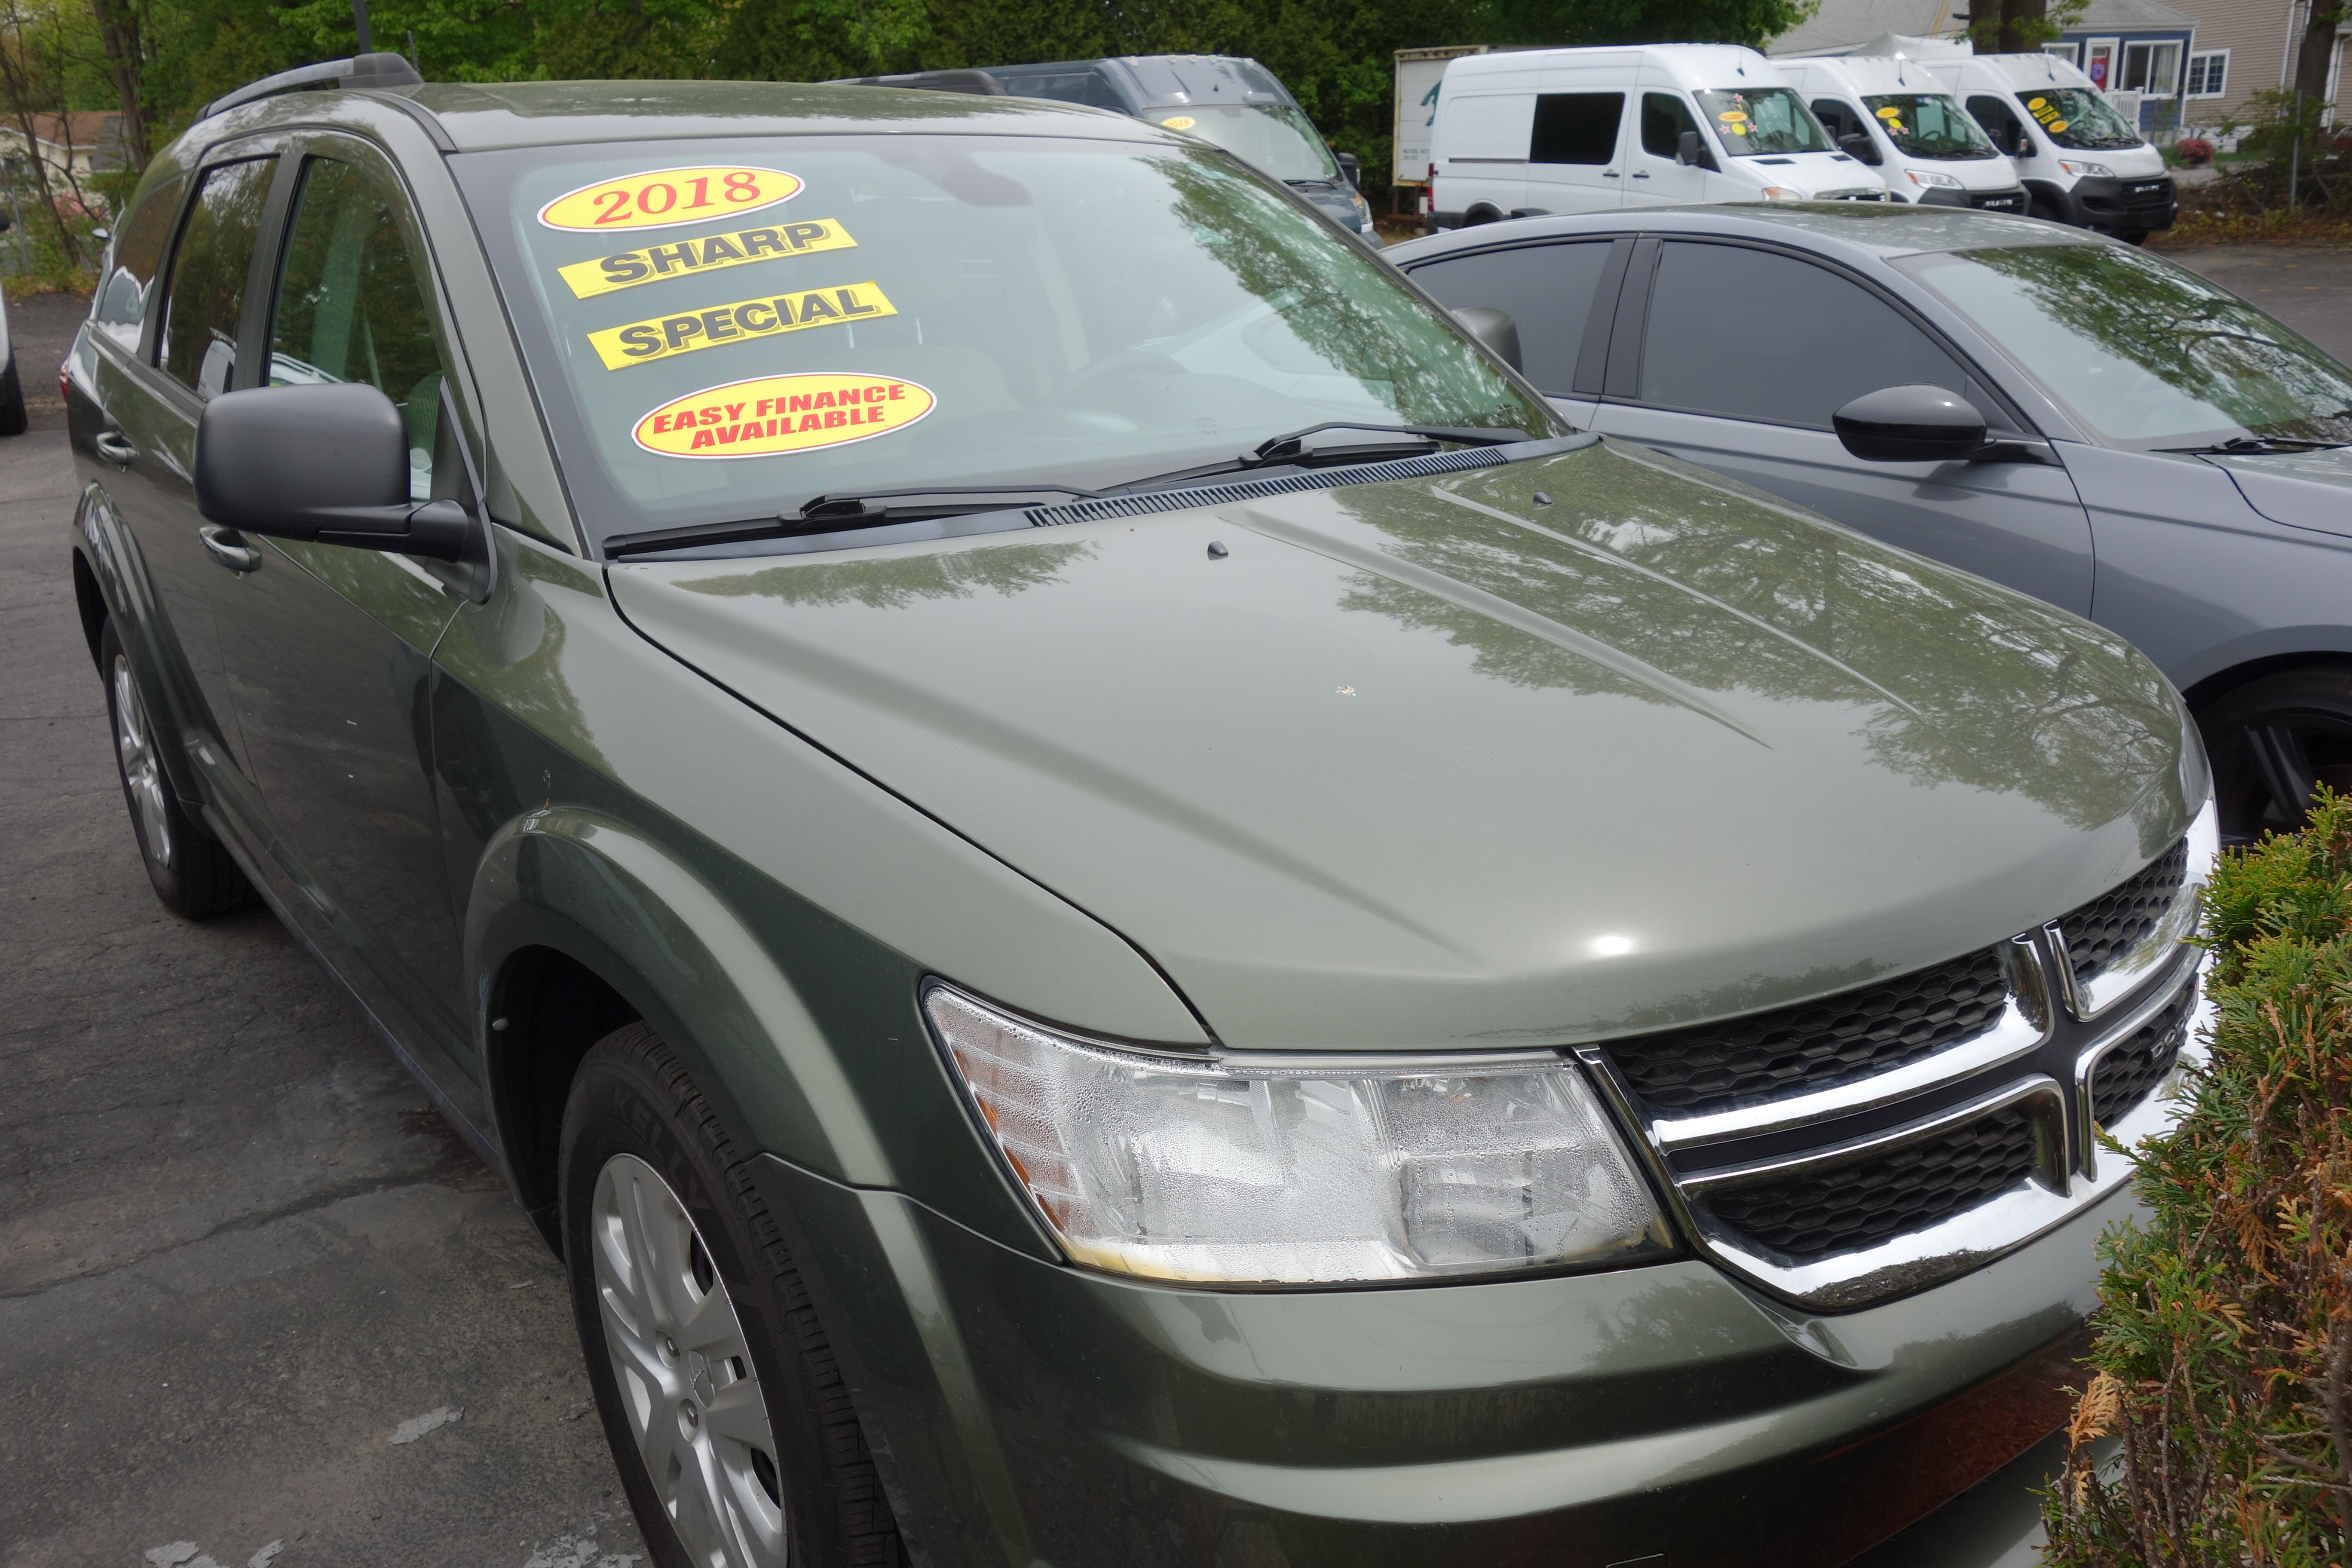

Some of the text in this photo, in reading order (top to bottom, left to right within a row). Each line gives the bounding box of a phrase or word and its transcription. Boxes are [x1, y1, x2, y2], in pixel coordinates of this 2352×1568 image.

[593, 171, 761, 225] 2018
[600, 223, 829, 284] SHARP
[619, 288, 879, 358] SPECIAL
[652, 383, 906, 434] EASY FINANCE
[690, 406, 885, 450] AVAILABLE
[612, 1084, 710, 1210] KELLY
